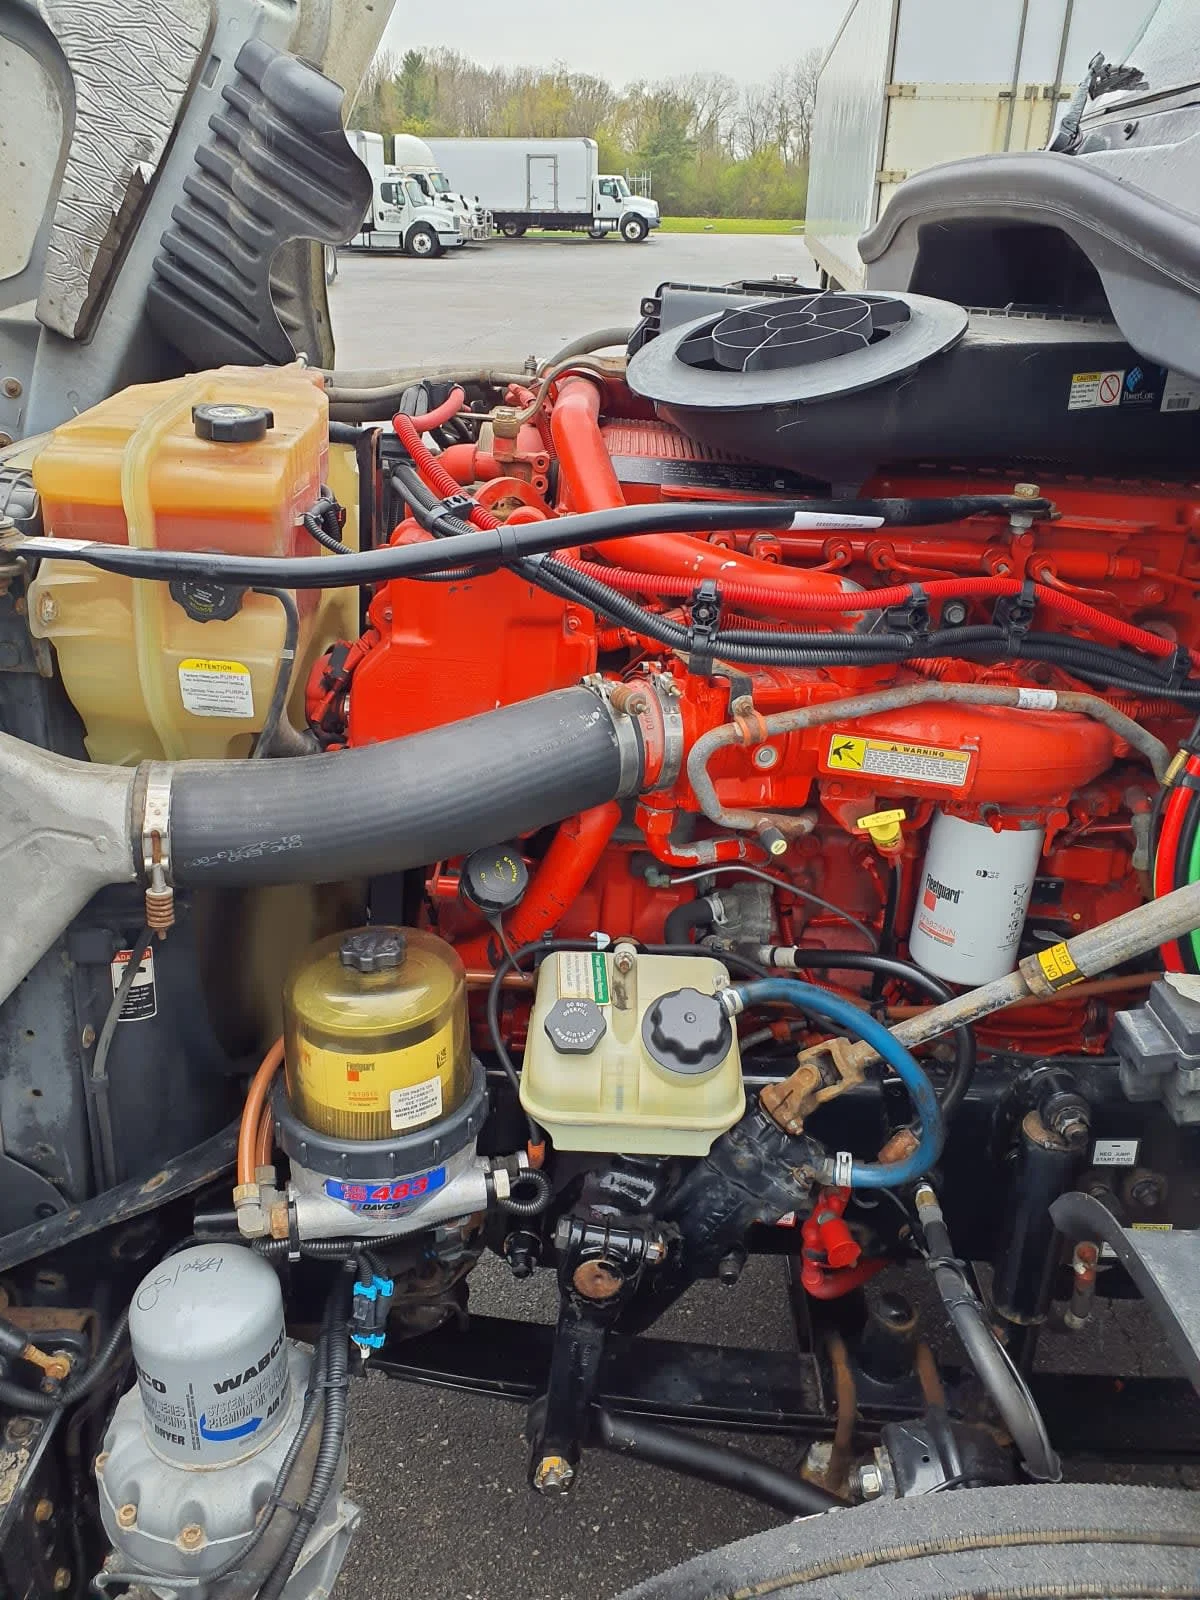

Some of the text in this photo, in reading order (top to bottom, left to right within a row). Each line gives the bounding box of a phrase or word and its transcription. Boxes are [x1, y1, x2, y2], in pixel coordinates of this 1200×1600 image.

[196, 663, 232, 671] ATTENTION
[903, 746, 945, 758] WARNING
[1055, 946, 1071, 966] STEP
[1044, 964, 1058, 978] NO
[562, 1007, 588, 1017] OVERFILL
[371, 1176, 429, 1201] 483
[362, 1202, 401, 1211] DAVCO
[207, 1402, 253, 1429] PREMIUM
[154, 1423, 185, 1446] DRYER
